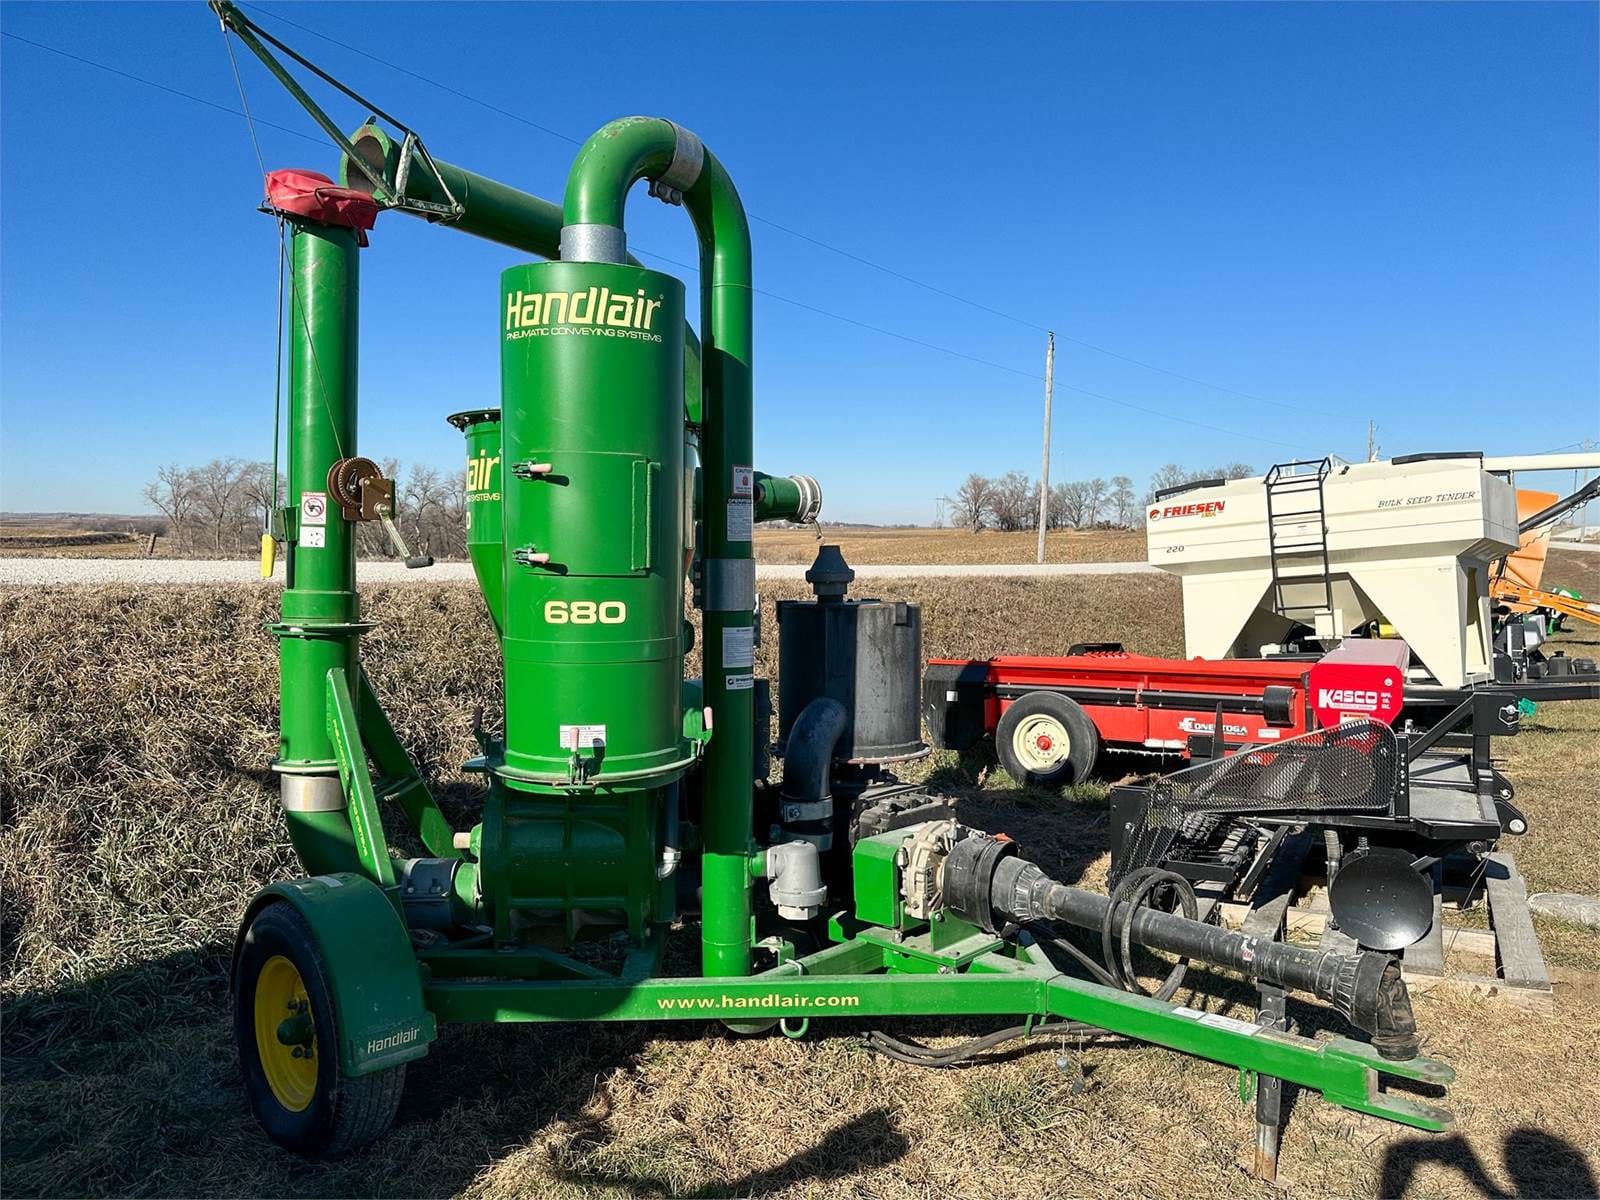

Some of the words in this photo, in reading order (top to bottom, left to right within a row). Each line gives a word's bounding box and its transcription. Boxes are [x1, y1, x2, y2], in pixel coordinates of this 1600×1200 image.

[506, 287, 661, 330] Handlair
[506, 327, 549, 340] PNEUMATIC
[550, 326, 616, 337] CONVEYING
[616, 330, 662, 343] SYSTEMS
[1163, 501, 1226, 517] FRIESEN
[1377, 499, 1403, 508] BULK
[1406, 496, 1432, 505] SEED
[1435, 491, 1475, 502] TENDER
[544, 601, 626, 624] 680
[1318, 688, 1378, 710] KASCO
[657, 994, 860, 1009] www.handlair.com
[367, 1027, 420, 1054] Handlair
